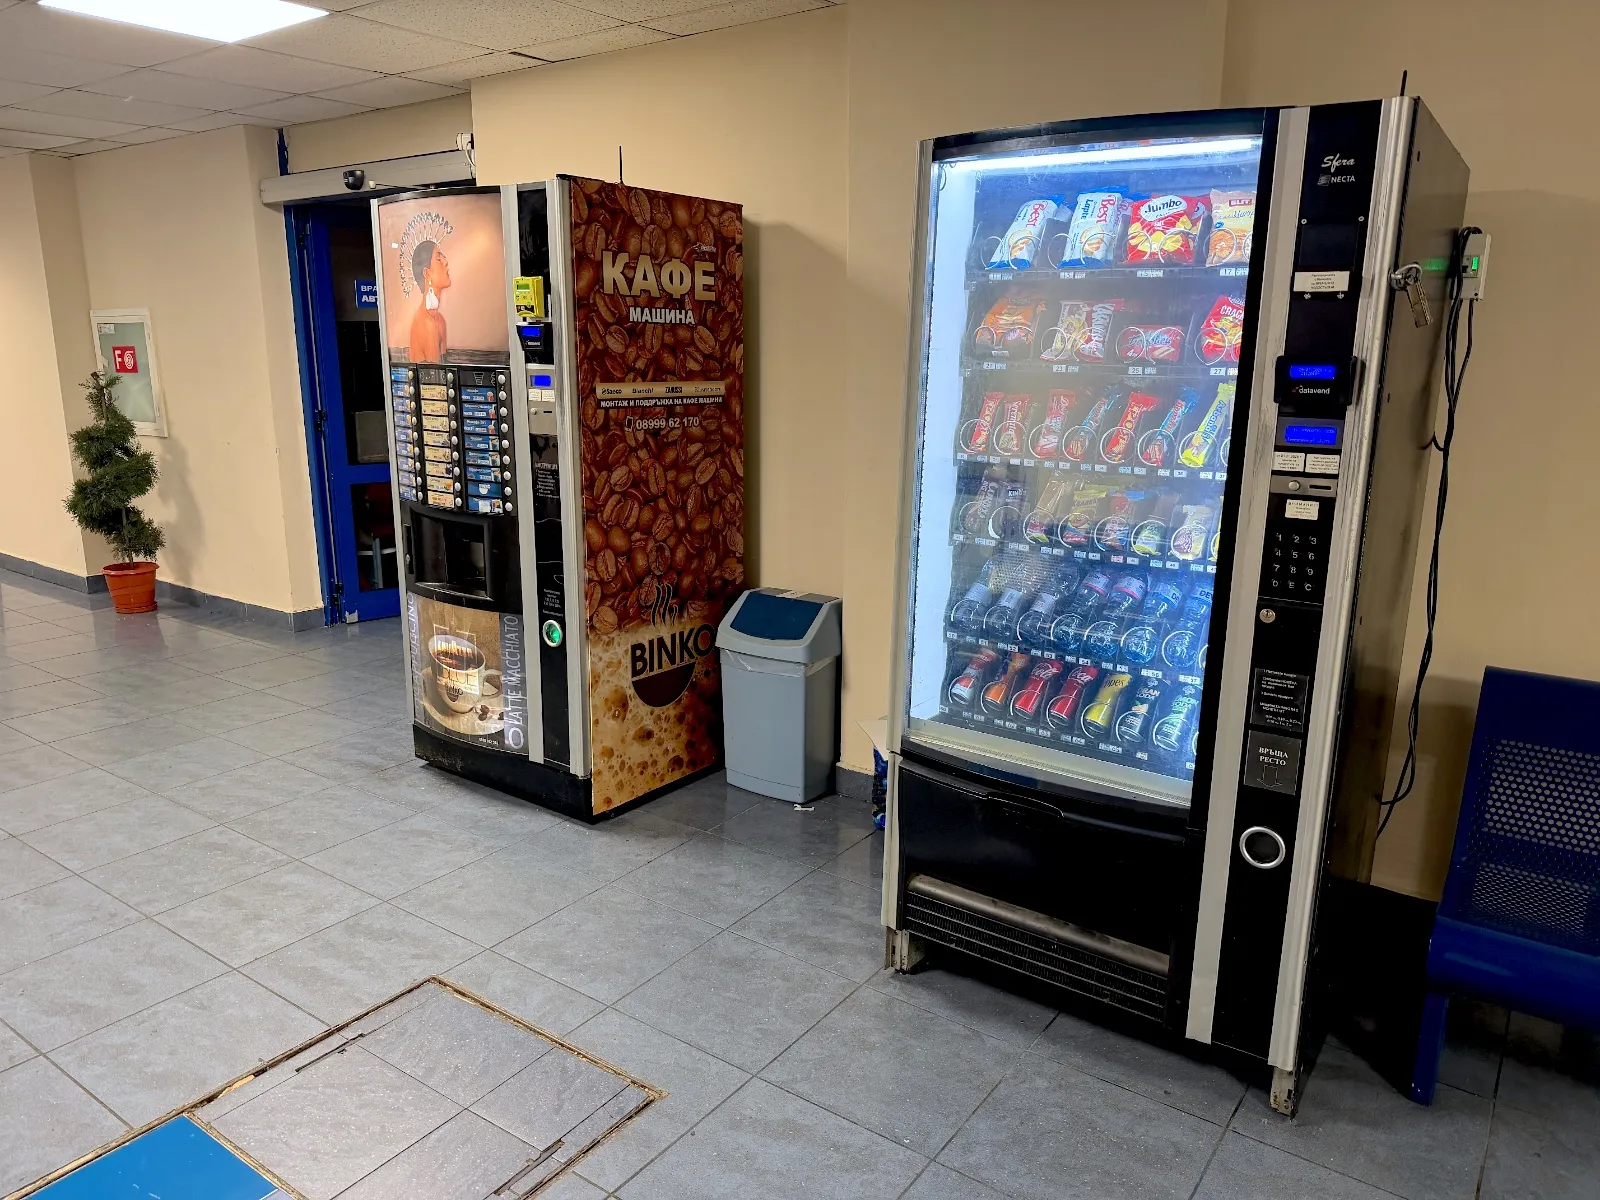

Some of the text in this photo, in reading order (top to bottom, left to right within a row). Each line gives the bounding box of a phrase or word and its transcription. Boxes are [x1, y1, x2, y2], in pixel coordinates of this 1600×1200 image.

[1321, 153, 1355, 172] Sfera
[1331, 175, 1356, 183] NECTA
[1144, 199, 1183, 214] Jumbo
[602, 250, 716, 301] КАФЕ
[629, 306, 695, 325] МАШИНА
[1298, 384, 1331, 395] datavend
[600, 400, 628, 408] МОНТАЖ
[636, 416, 700, 430] 08999 62 170
[631, 624, 715, 679] BINKO
[502, 615, 522, 725] LATTE MACCHIATO
[1258, 746, 1289, 759] ВРЪЩА
[1259, 756, 1286, 766] РЕСТО
